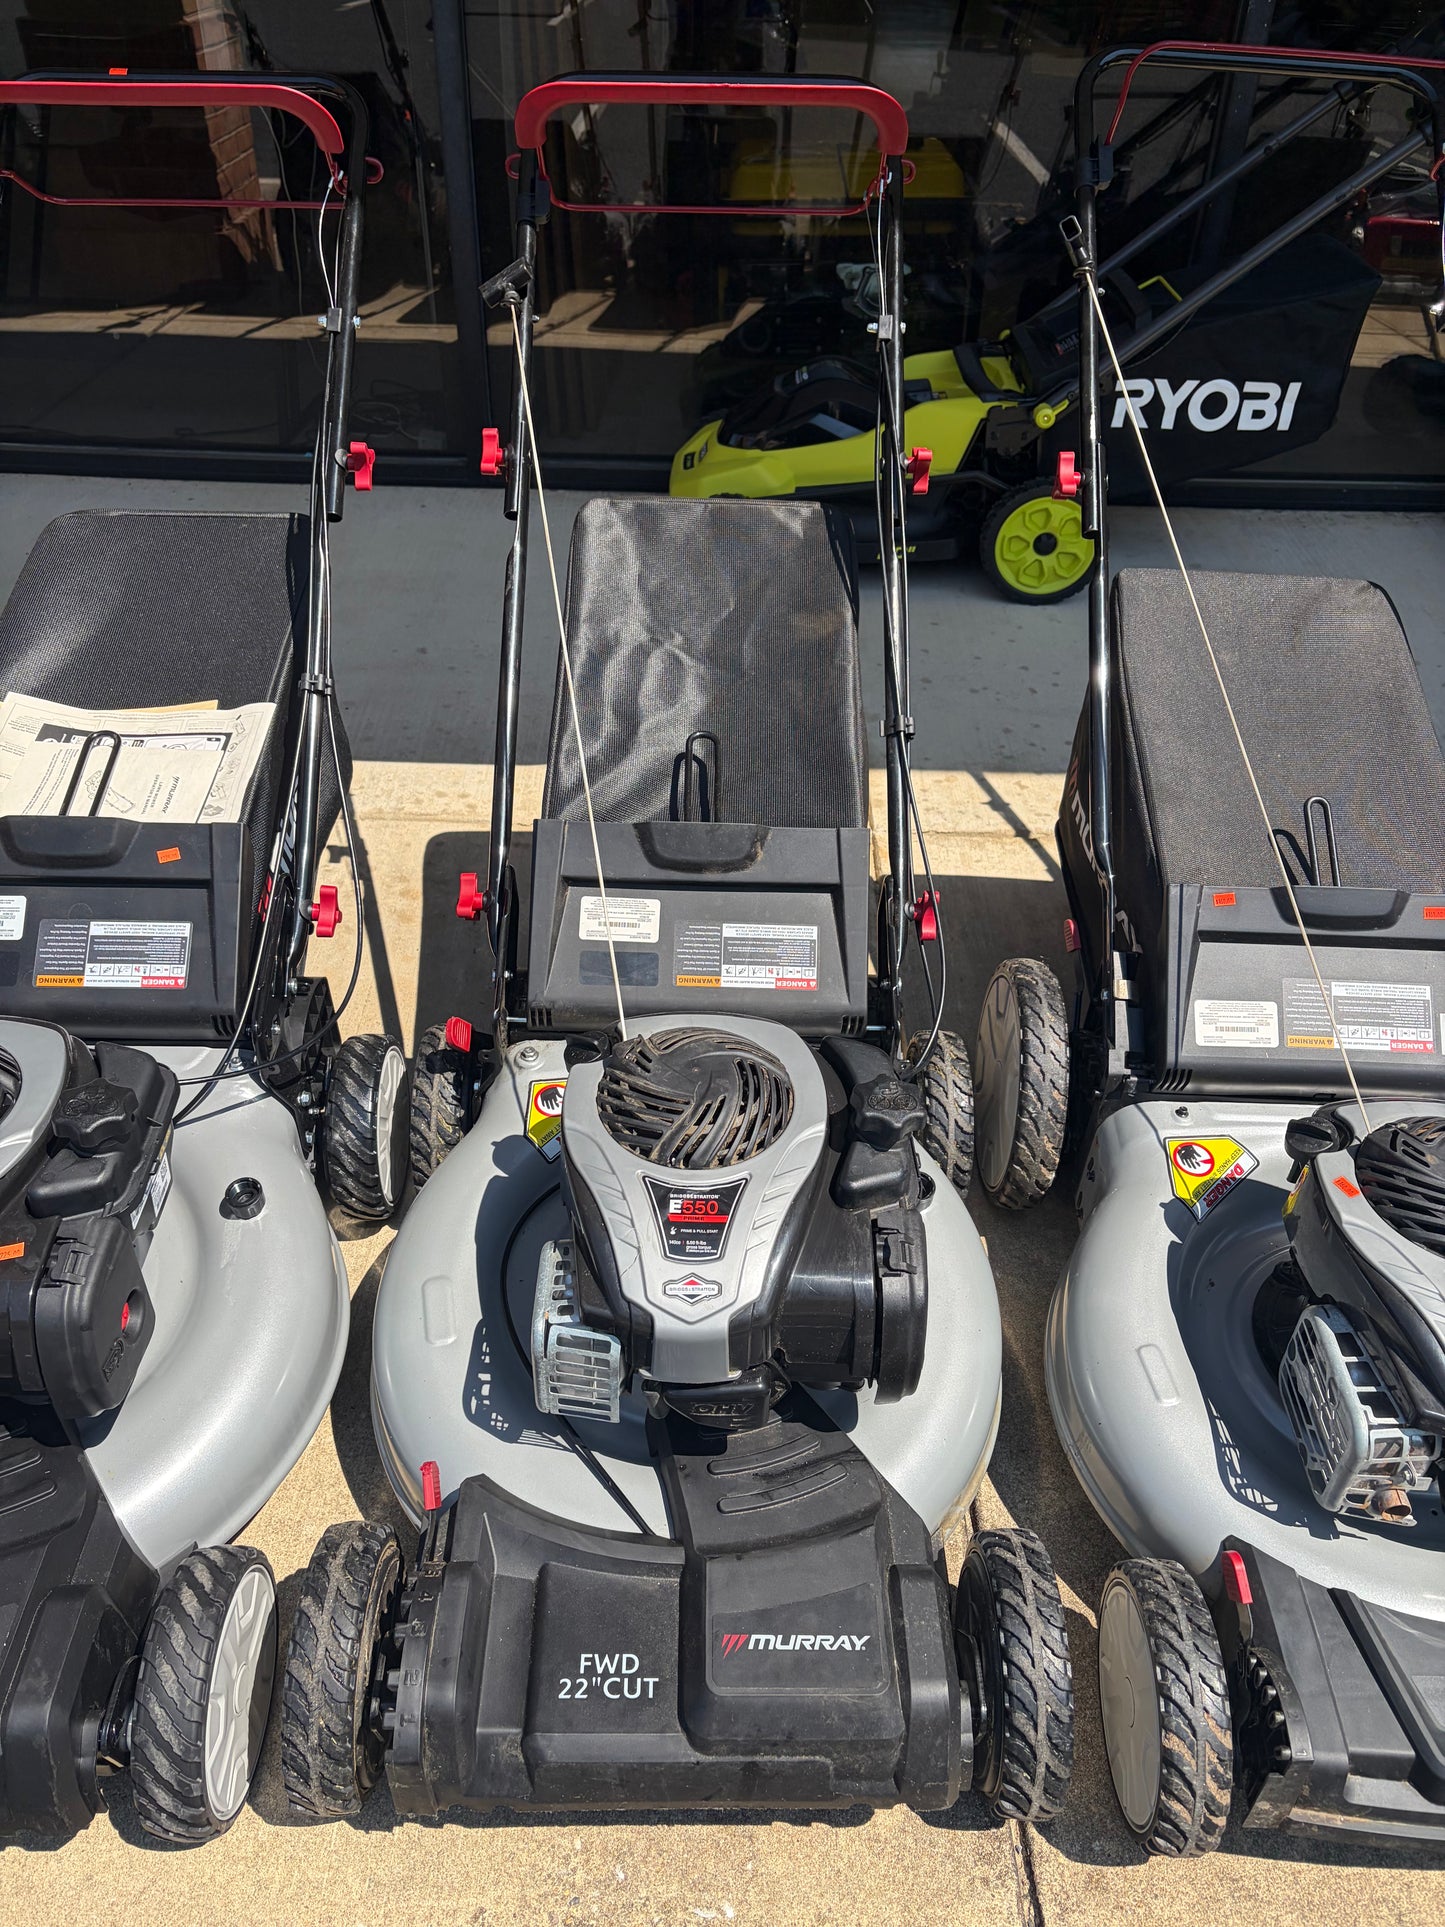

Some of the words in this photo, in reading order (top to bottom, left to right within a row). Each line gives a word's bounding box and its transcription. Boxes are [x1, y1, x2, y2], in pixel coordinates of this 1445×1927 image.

[1110, 378, 1302, 432] RYOBI
[142, 978, 175, 986] DANGER
[1289, 1037, 1326, 1045] WARNING
[1230, 1148, 1242, 1161] KEEP
[1216, 1158, 1232, 1175] HANDS
[1202, 1162, 1245, 1209] DANGER
[747, 1634, 871, 1651] MURRAY
[579, 1653, 640, 1674] FWD
